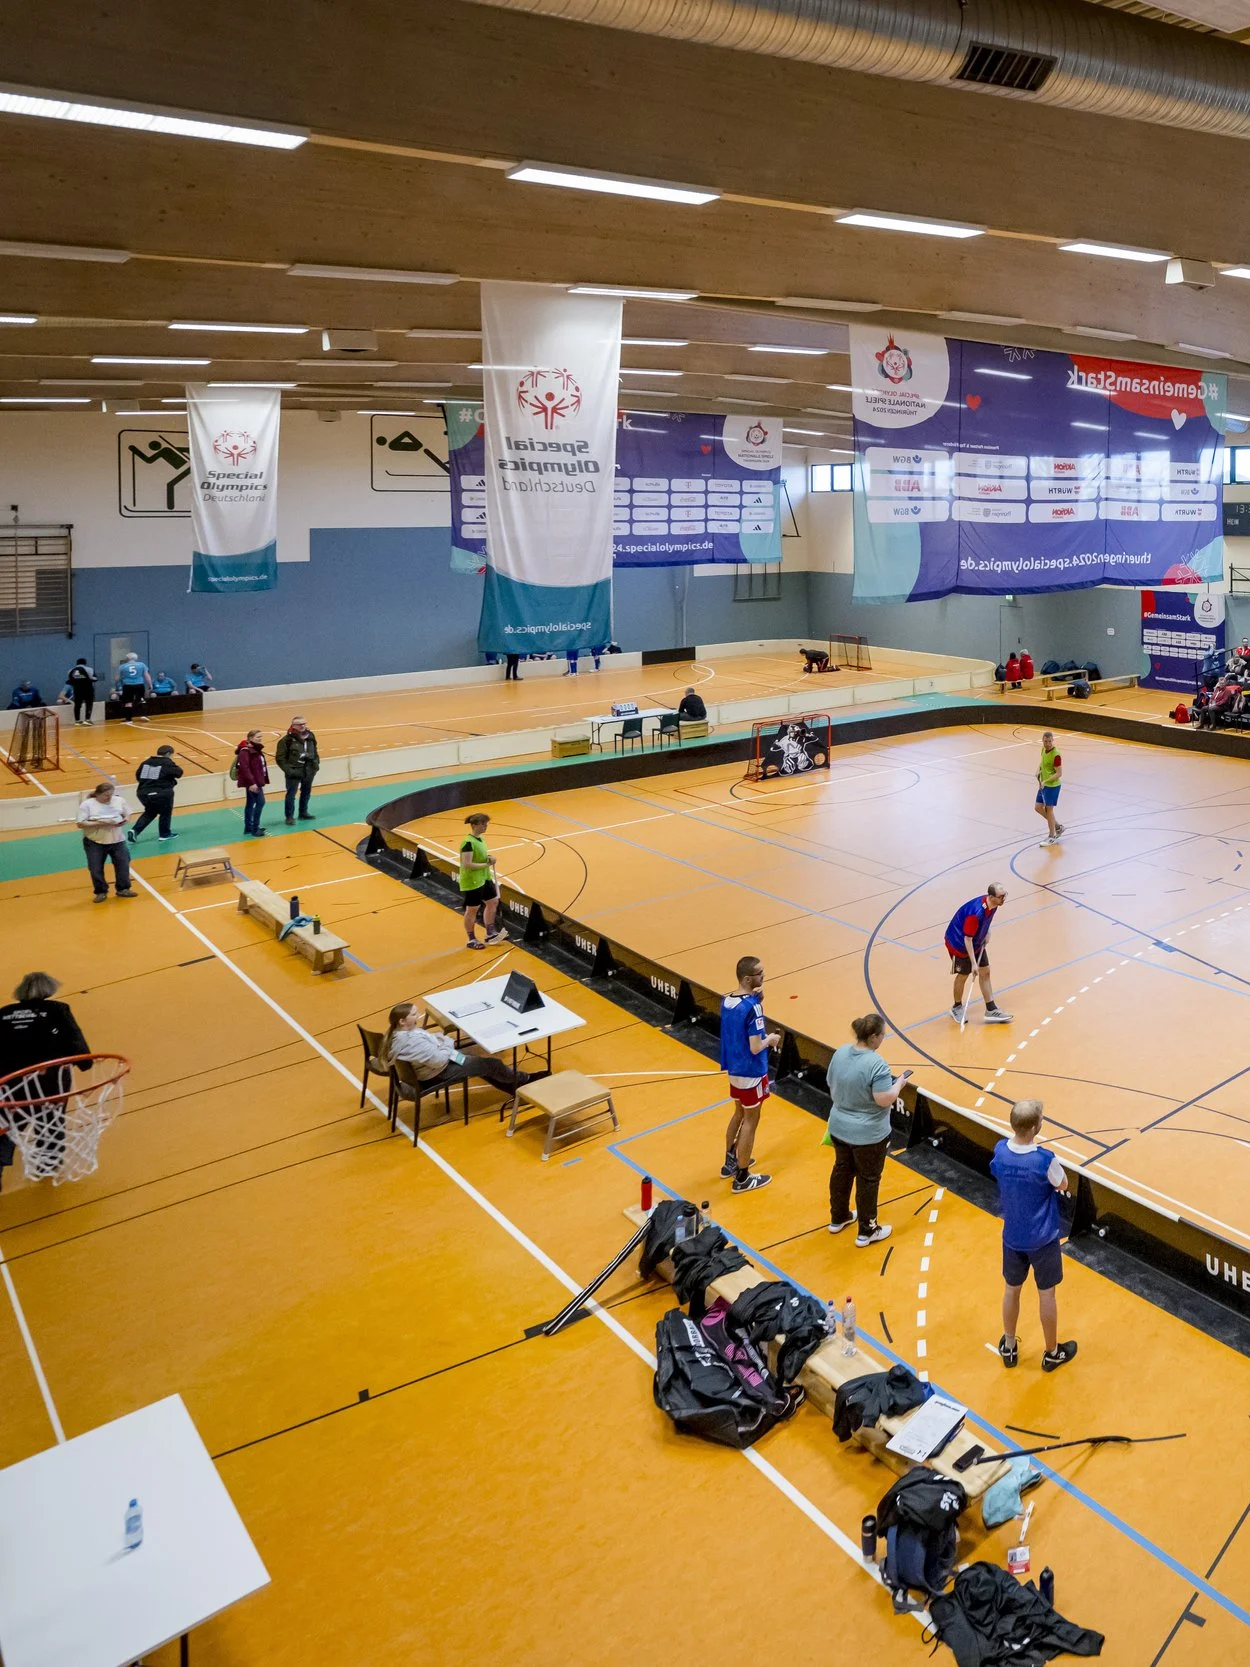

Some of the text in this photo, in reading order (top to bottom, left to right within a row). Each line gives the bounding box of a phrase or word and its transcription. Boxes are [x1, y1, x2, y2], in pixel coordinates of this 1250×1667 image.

[206, 470, 264, 480] Special
[200, 481, 268, 492] Olympics
[128, 665, 137, 676] 5
[509, 899, 530, 919] UHER
[575, 934, 598, 956] UHER
